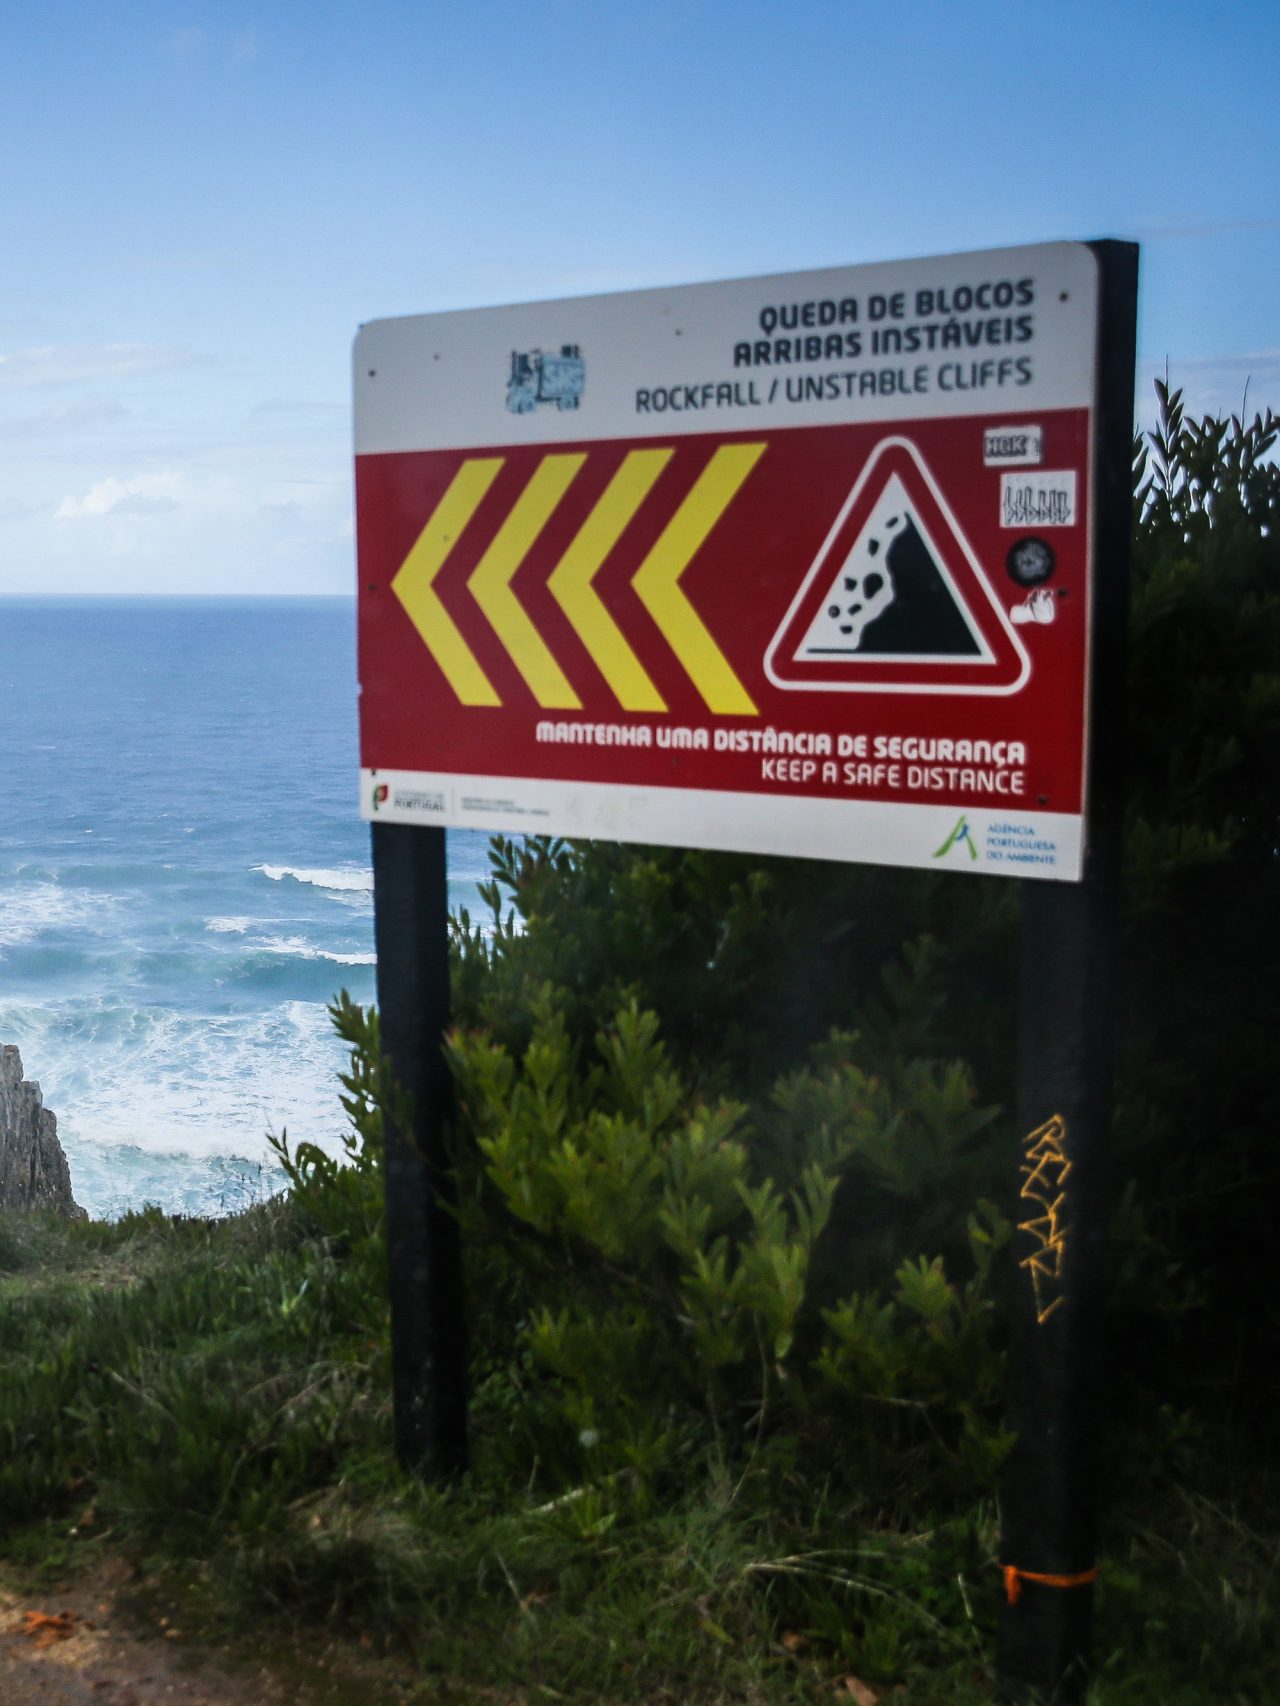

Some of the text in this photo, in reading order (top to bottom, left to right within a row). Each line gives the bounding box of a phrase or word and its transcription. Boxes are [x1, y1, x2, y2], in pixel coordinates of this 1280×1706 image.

[759, 278, 1034, 335] QUEDA DE BLOCOS
[733, 315, 1033, 368] ARRIBAS INSTÁVEIS
[636, 357, 1032, 414] ROCKFALL / UNSTABLE CLIFFS
[535, 721, 1026, 769] MANTENHA UMA DISTÂNCIA DE SEGURANÇA
[761, 758, 1025, 795] KEEP A SAFE DISTANCE
[987, 838, 1056, 850] PORTUGUESA
[1007, 853, 1056, 864] AMBIENTE
